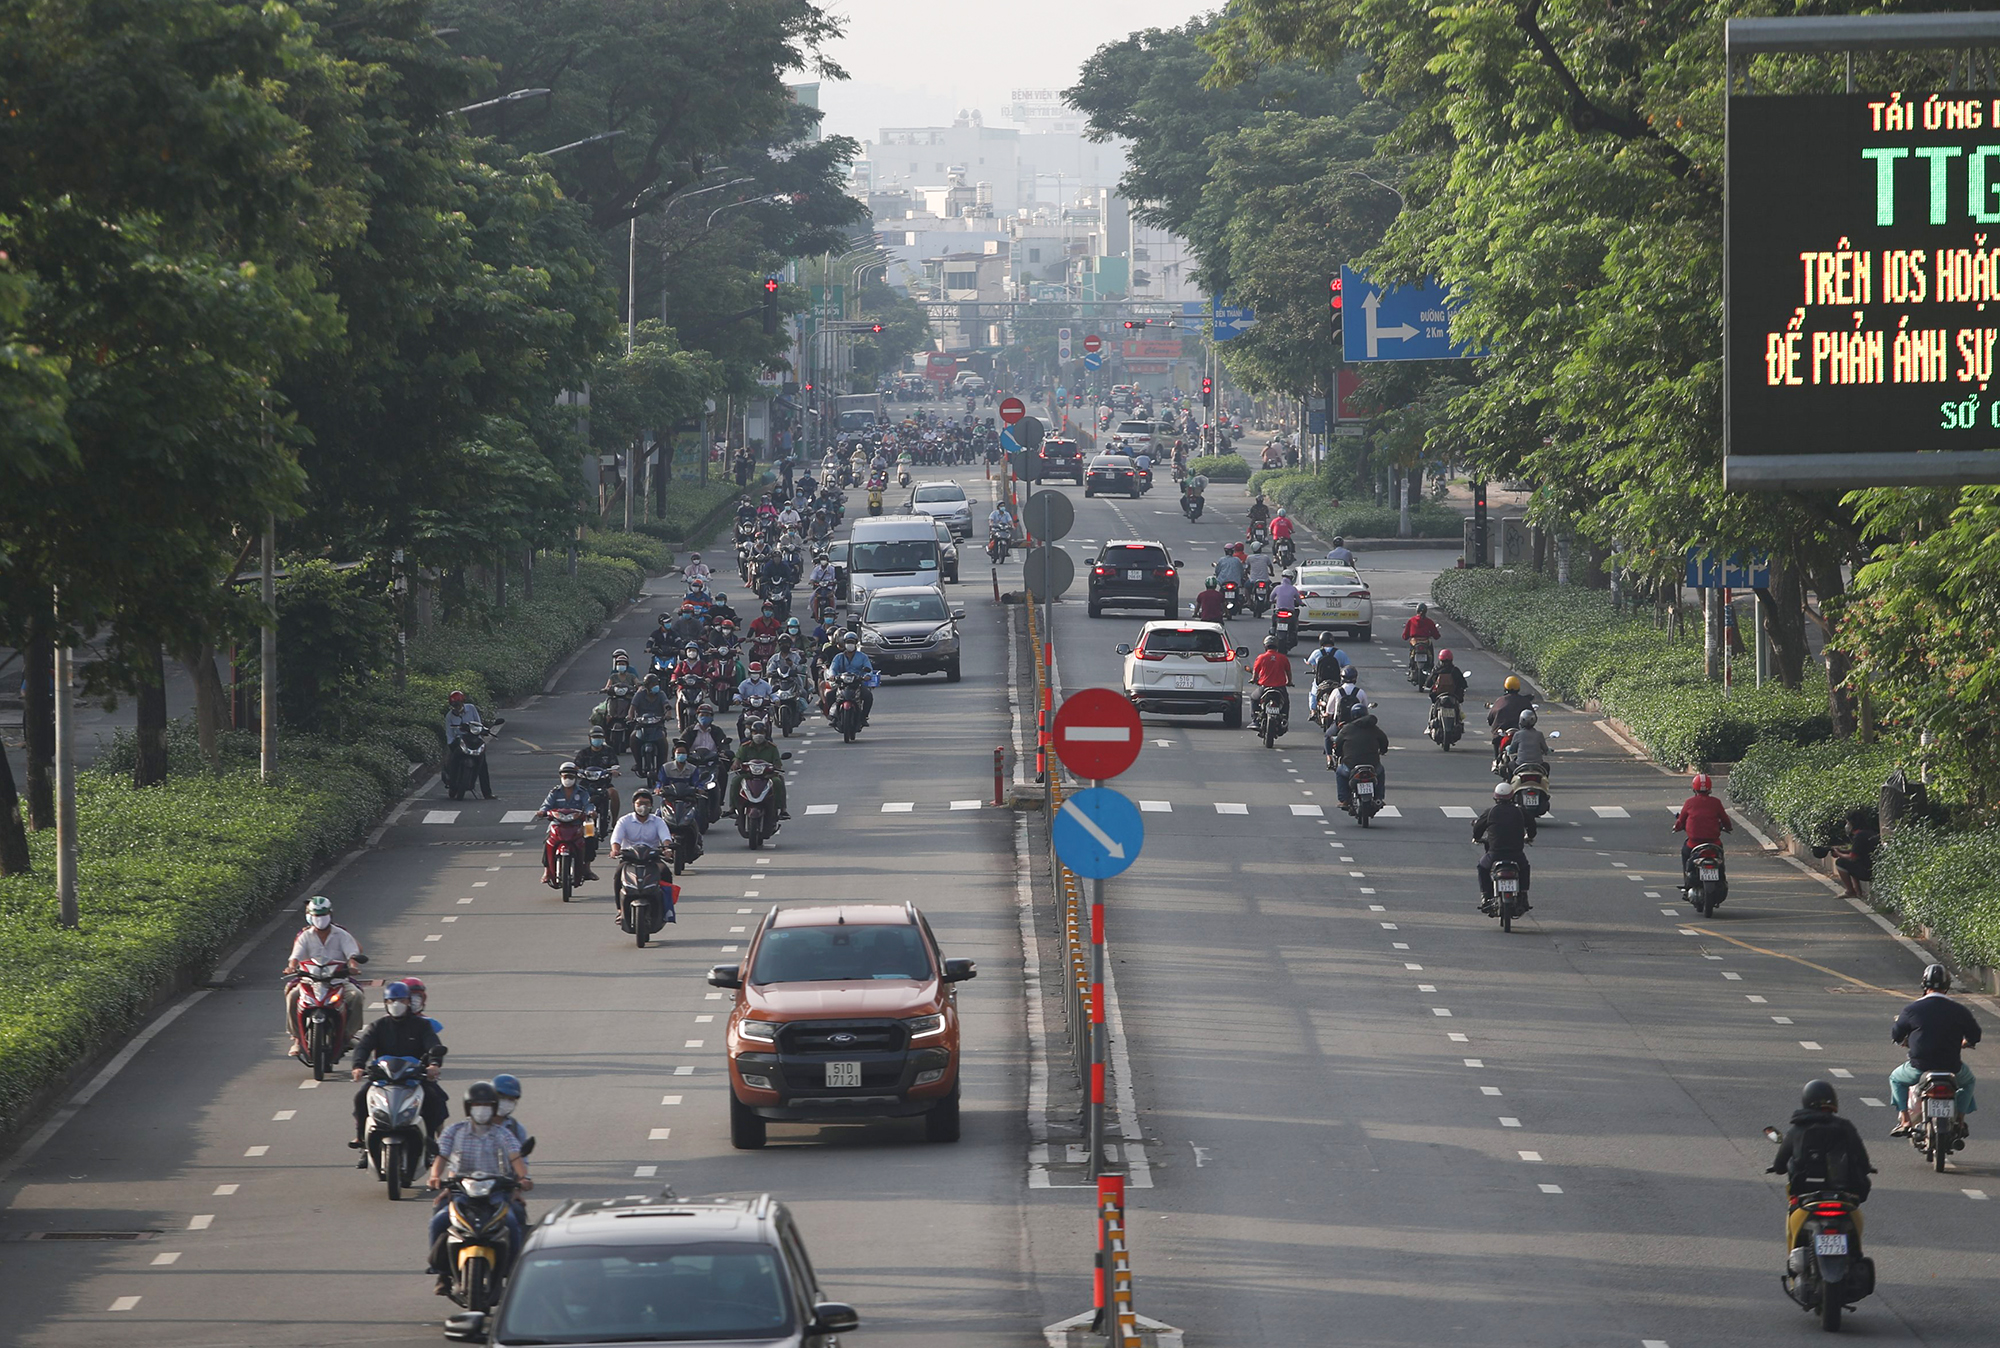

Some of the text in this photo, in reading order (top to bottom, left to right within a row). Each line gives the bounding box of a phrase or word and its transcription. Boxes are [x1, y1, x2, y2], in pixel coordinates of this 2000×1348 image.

[1012, 89, 1032, 101] BỆNH
[1035, 89, 1052, 101] VIỆN
[1868, 92, 1914, 131] TẢI
[1924, 94, 1982, 130] ỨNG
[1862, 145, 2000, 226] TTG
[1800, 237, 1871, 306] TRÊN
[1883, 250, 1927, 304] IOS
[1215, 308, 1225, 318] BẾN
[1420, 308, 1445, 322] ĐƯỜNG
[1766, 308, 1998, 391] ĐỂ PHẢN ÁNH SỰ
[1940, 394, 1981, 430] SỞ
[833, 1064, 852, 1075] 51D
